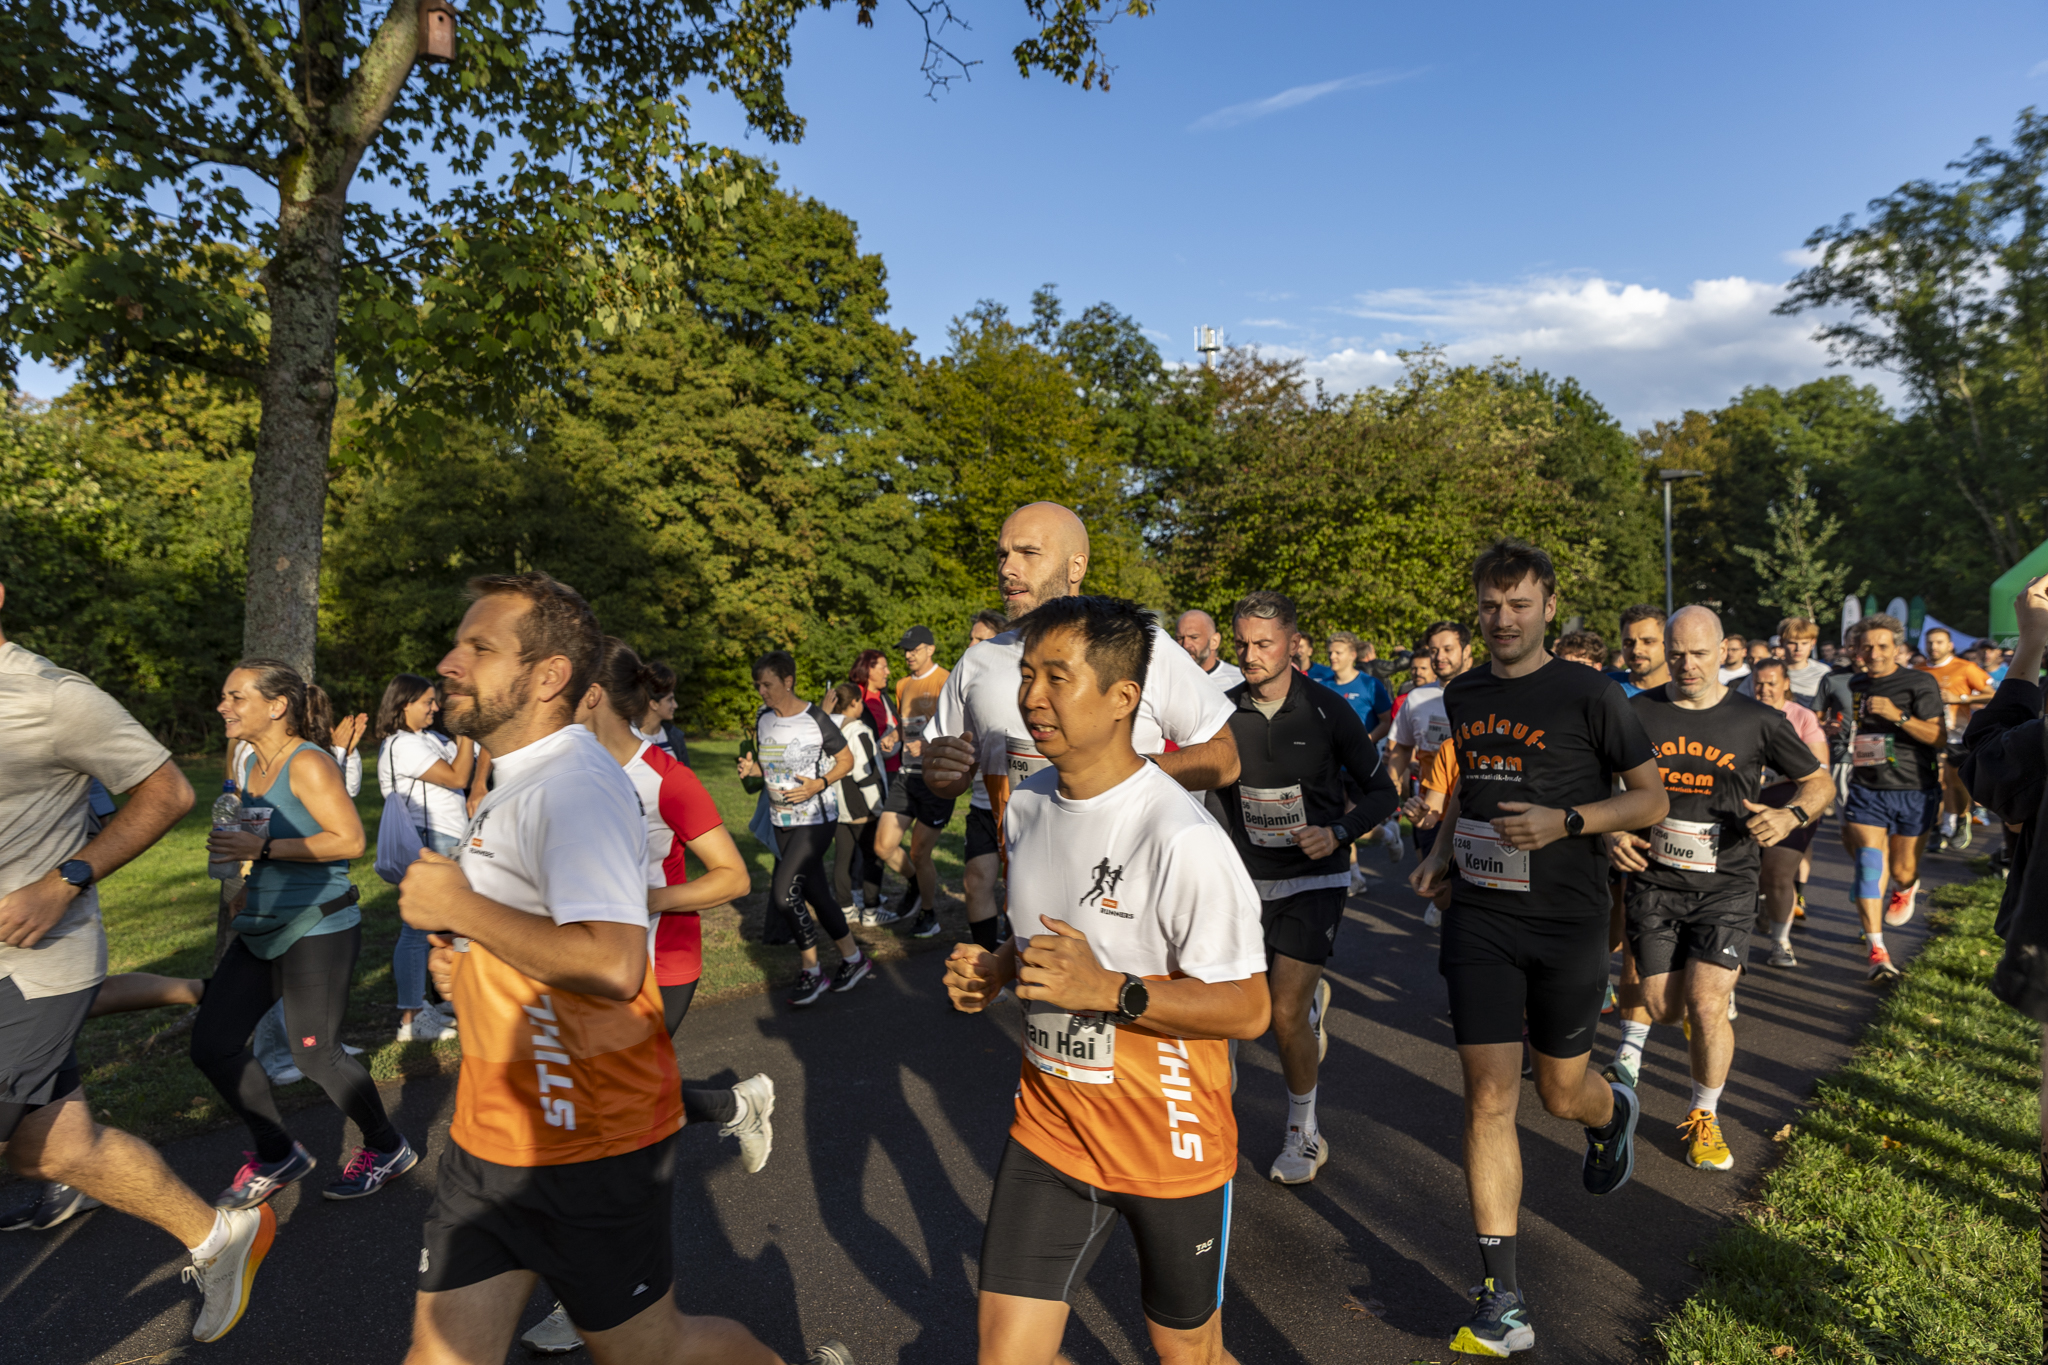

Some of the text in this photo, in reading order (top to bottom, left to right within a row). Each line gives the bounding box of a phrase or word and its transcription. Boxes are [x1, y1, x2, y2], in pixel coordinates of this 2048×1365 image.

[1008, 759, 1028, 771] 1490
[1466, 751, 1522, 772] Team
[1658, 767, 1714, 787] Team
[1242, 801, 1250, 809] 56
[1244, 811, 1300, 828] Benjamin
[1454, 838, 1471, 850] 1248
[1664, 842, 1694, 858] Uwe
[1465, 853, 1504, 873] Kevin
[1056, 1031, 1095, 1060] Hai
[522, 995, 576, 1130] STIHL
[1157, 1037, 1204, 1162] STIHL
[1196, 1239, 1214, 1251] TAO
